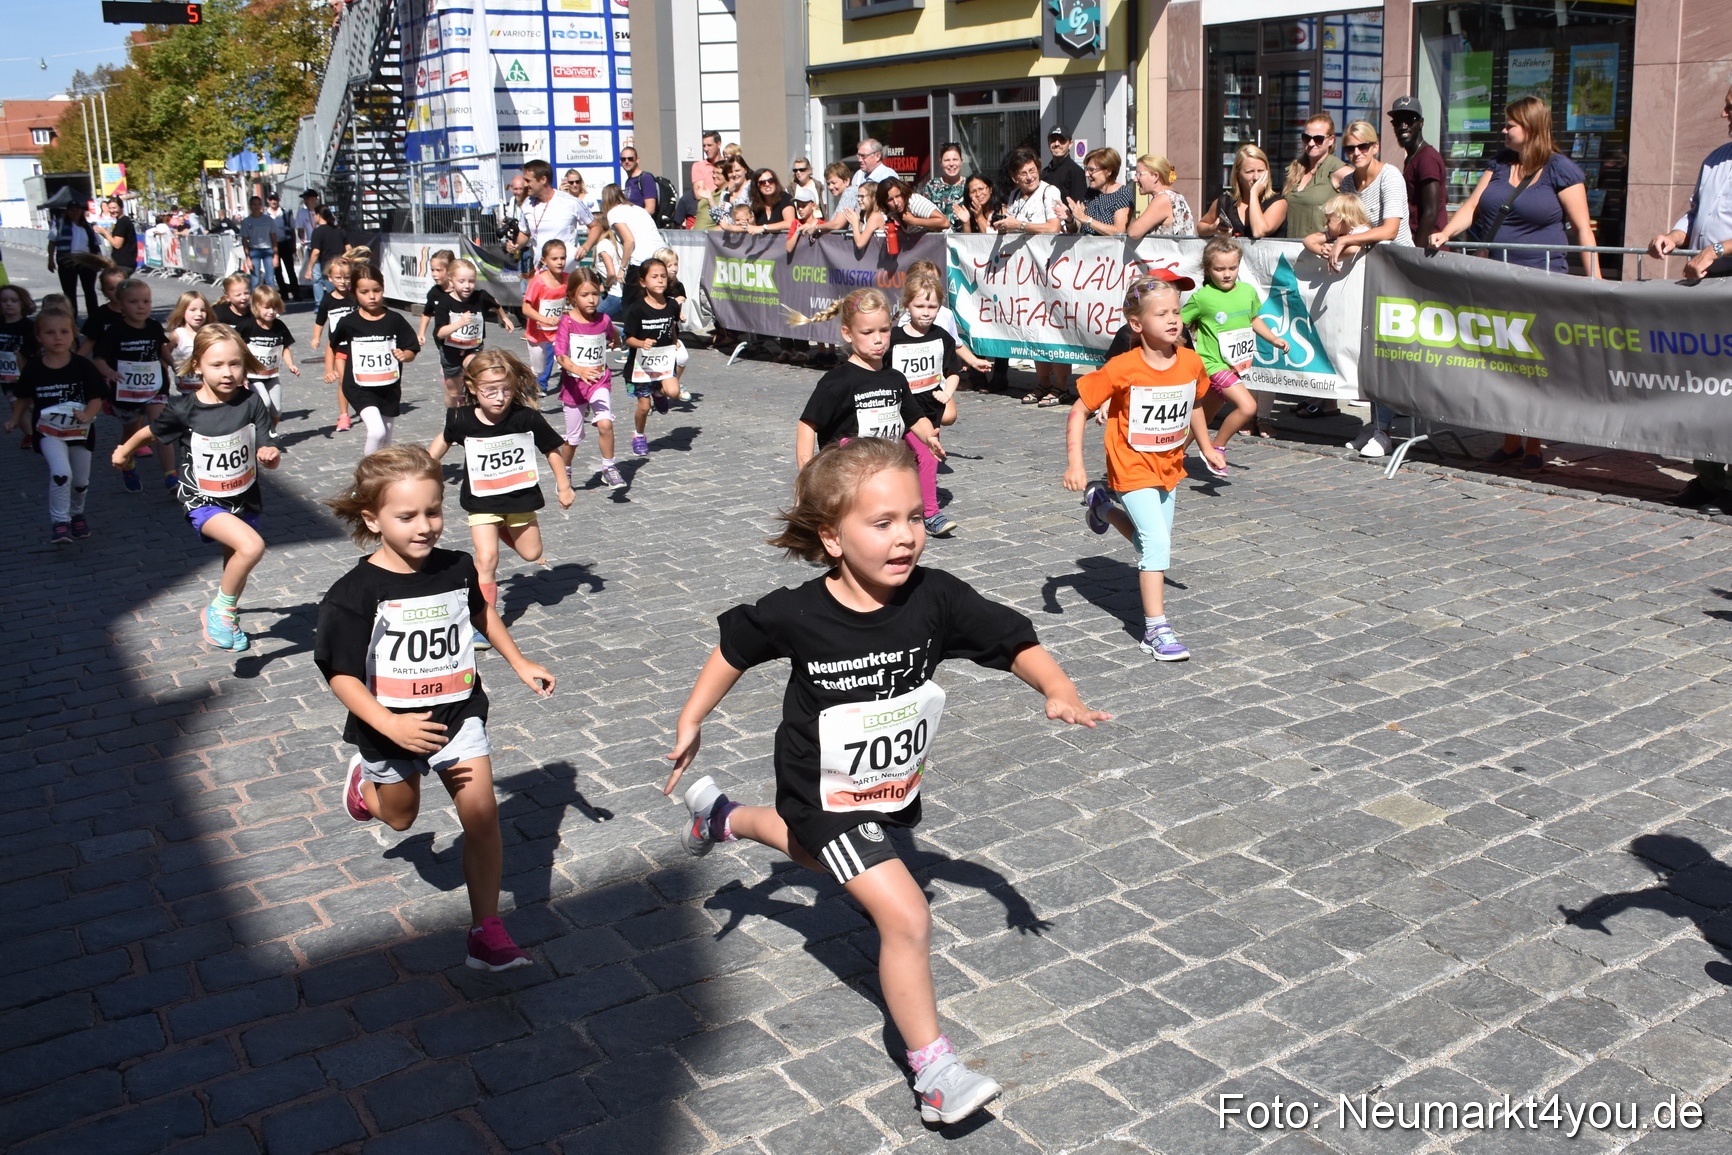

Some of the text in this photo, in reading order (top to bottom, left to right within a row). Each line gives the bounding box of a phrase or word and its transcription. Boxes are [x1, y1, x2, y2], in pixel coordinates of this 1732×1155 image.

[187, 4, 199, 23] 5
[1069, 6, 1089, 36] G2
[503, 30, 541, 38] VARIOTEC
[1512, 57, 1551, 68] Radfahren
[887, 147, 904, 155] HAPPY
[401, 255, 417, 276] swn
[714, 258, 776, 290] BOCK
[1017, 256, 1069, 289] UNS
[793, 266, 827, 283] OFFICE
[829, 268, 876, 287] INDUSTRY
[752, 296, 780, 306] concepts
[460, 324, 479, 335] 025
[1377, 299, 1538, 356] BOCK
[1554, 322, 1642, 352] OFFICE
[576, 346, 603, 360] 7452
[1228, 340, 1254, 358] 7082
[359, 353, 392, 367] 7518
[901, 355, 935, 373] 7501
[1374, 344, 1548, 378] inspired by smart concepts
[125, 373, 155, 385] 7032
[1252, 373, 1282, 386] Gebäude
[1284, 376, 1308, 388] Service
[1310, 378, 1336, 391] GmbH
[1608, 370, 1732, 396] www.boc
[854, 389, 892, 401] Neumarkter
[1152, 391, 1183, 400] BOCK
[1142, 401, 1188, 424] 7444
[210, 437, 241, 449] BOCK
[1156, 436, 1174, 444] Lena
[202, 445, 249, 471] 7469
[477, 447, 525, 471] 7552
[221, 480, 243, 490] Frida
[403, 604, 449, 621] BOCK
[385, 623, 460, 663] 7050
[392, 664, 452, 675] PARTL Neumarkt
[808, 651, 904, 675] Neumarkter
[412, 682, 443, 695] Lara
[863, 702, 918, 729] BOCK
[844, 718, 928, 777] 7030
[853, 764, 916, 786] PARTL Neumarkt
